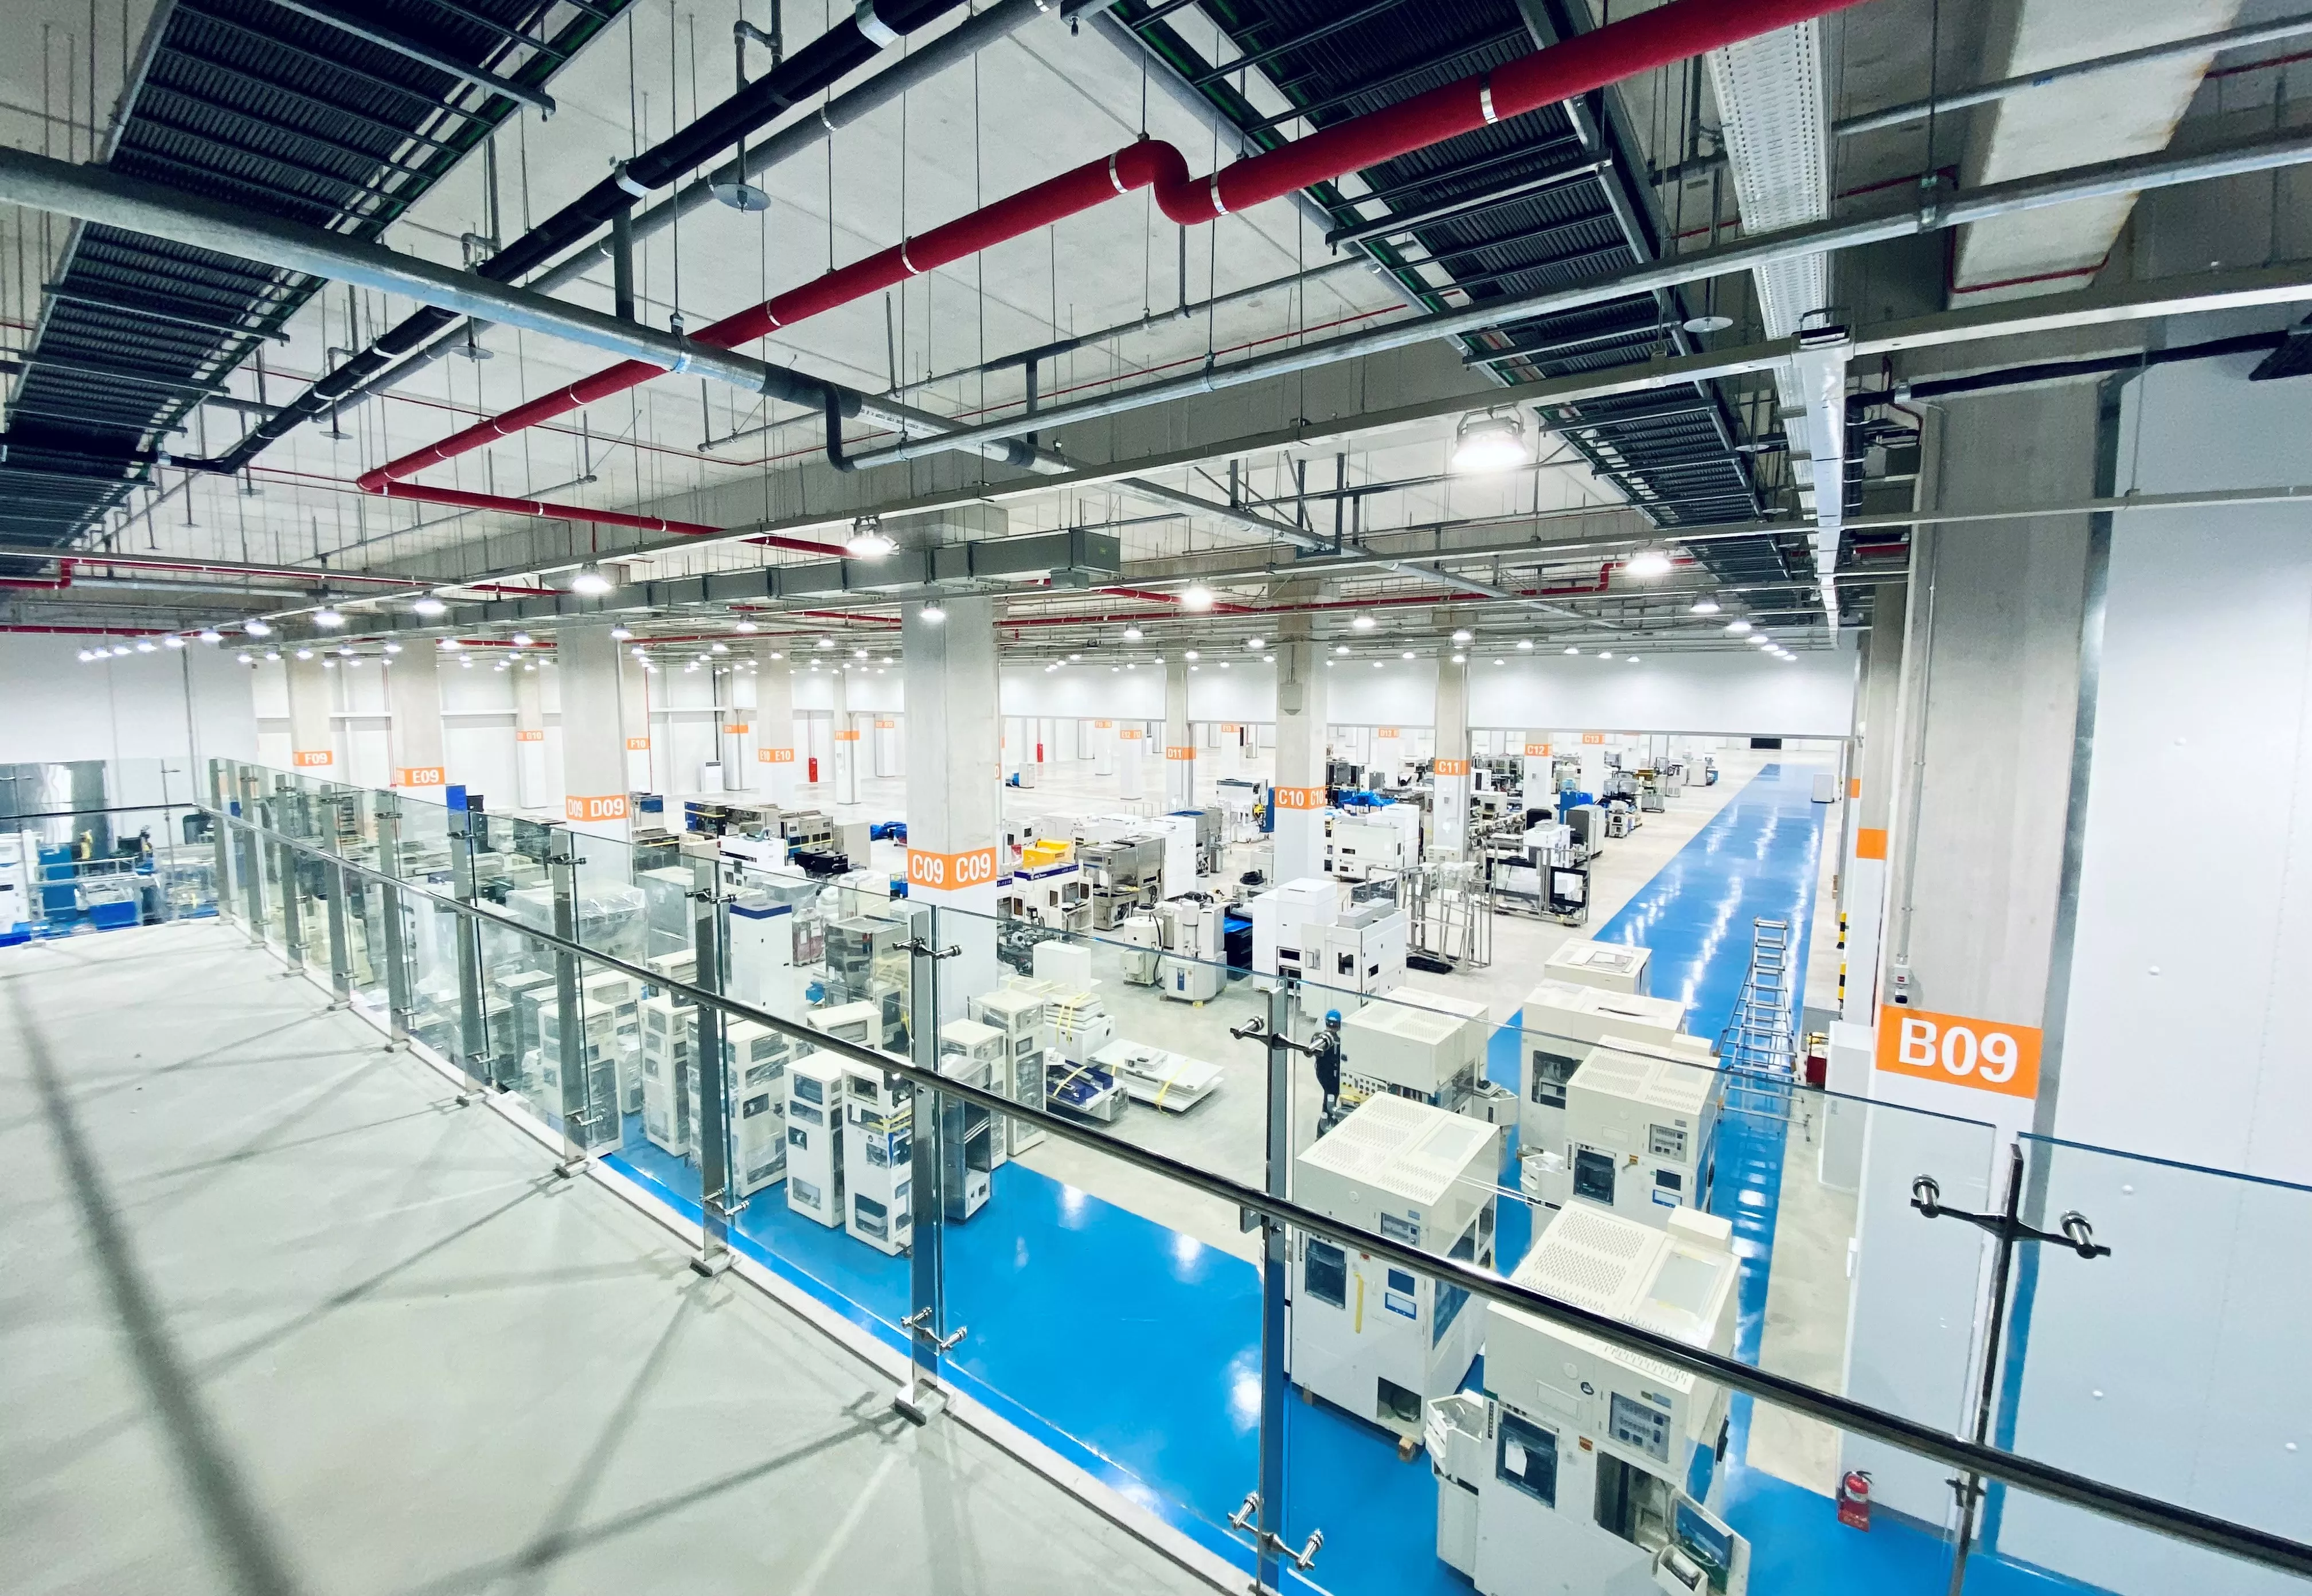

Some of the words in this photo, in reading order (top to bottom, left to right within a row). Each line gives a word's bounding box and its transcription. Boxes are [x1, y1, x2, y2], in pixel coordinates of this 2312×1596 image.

[630, 739, 646, 748] F10
[1585, 735, 1599, 743] C13
[760, 750, 771, 761] E10
[775, 750, 791, 761] E10
[1168, 748, 1181, 758] D11
[1527, 745, 1545, 755] C12
[304, 753, 327, 764] F09
[1439, 761, 1459, 773] C11
[413, 769, 439, 784] E09
[1279, 789, 1305, 807] C10
[1310, 789, 1323, 806] C10
[567, 799, 583, 818] D09
[590, 798, 624, 817] D09
[912, 854, 944, 884] C09
[956, 853, 991, 883] C09
[1899, 1017, 2018, 1083] B09
